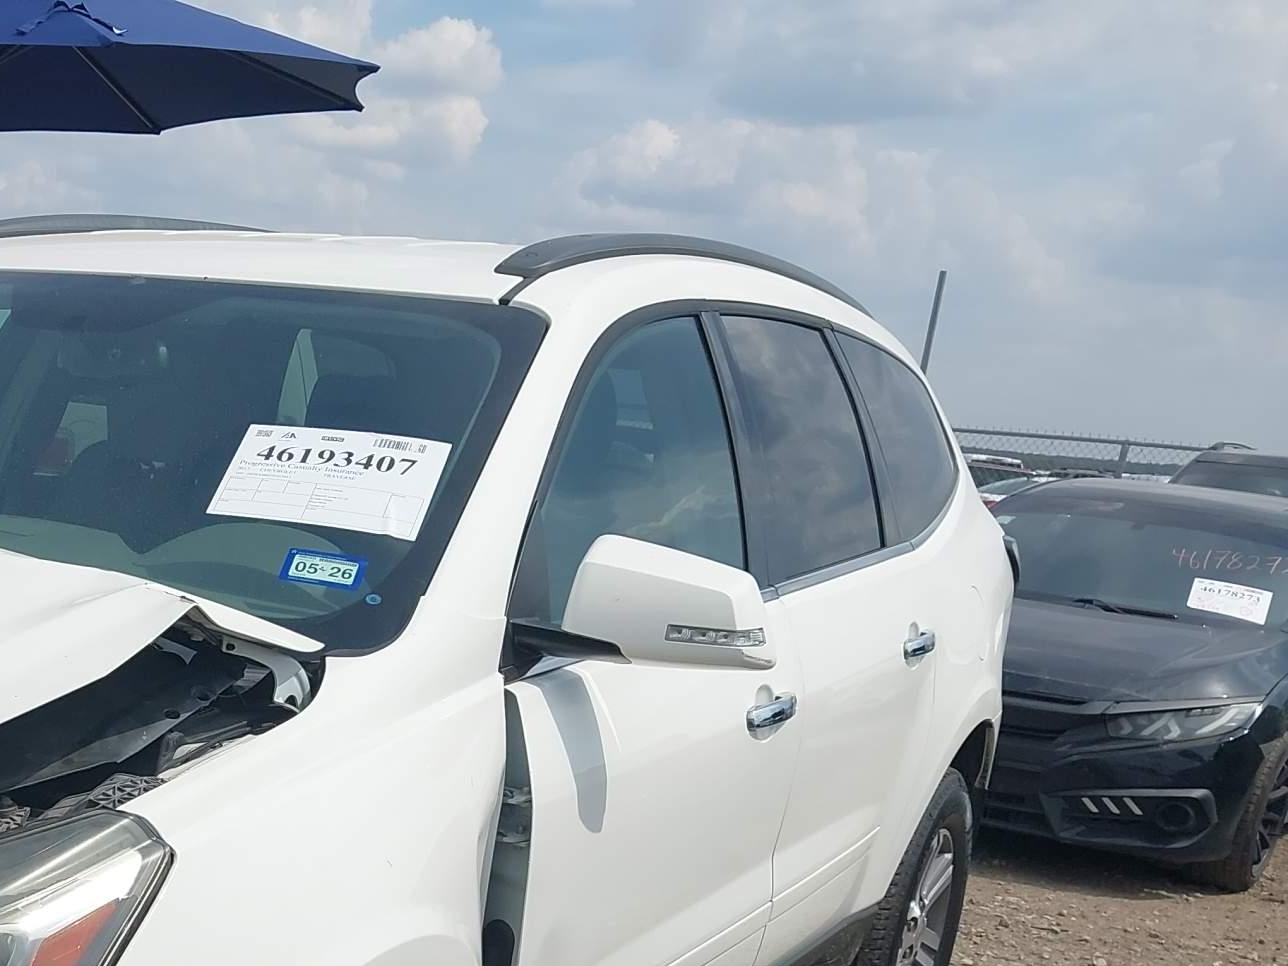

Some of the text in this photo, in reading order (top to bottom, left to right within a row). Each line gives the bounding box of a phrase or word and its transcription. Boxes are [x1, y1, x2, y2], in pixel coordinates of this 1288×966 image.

[256, 444, 419, 476] 46193407
[294, 561, 319, 575] 05
[328, 566, 354, 580] 26
